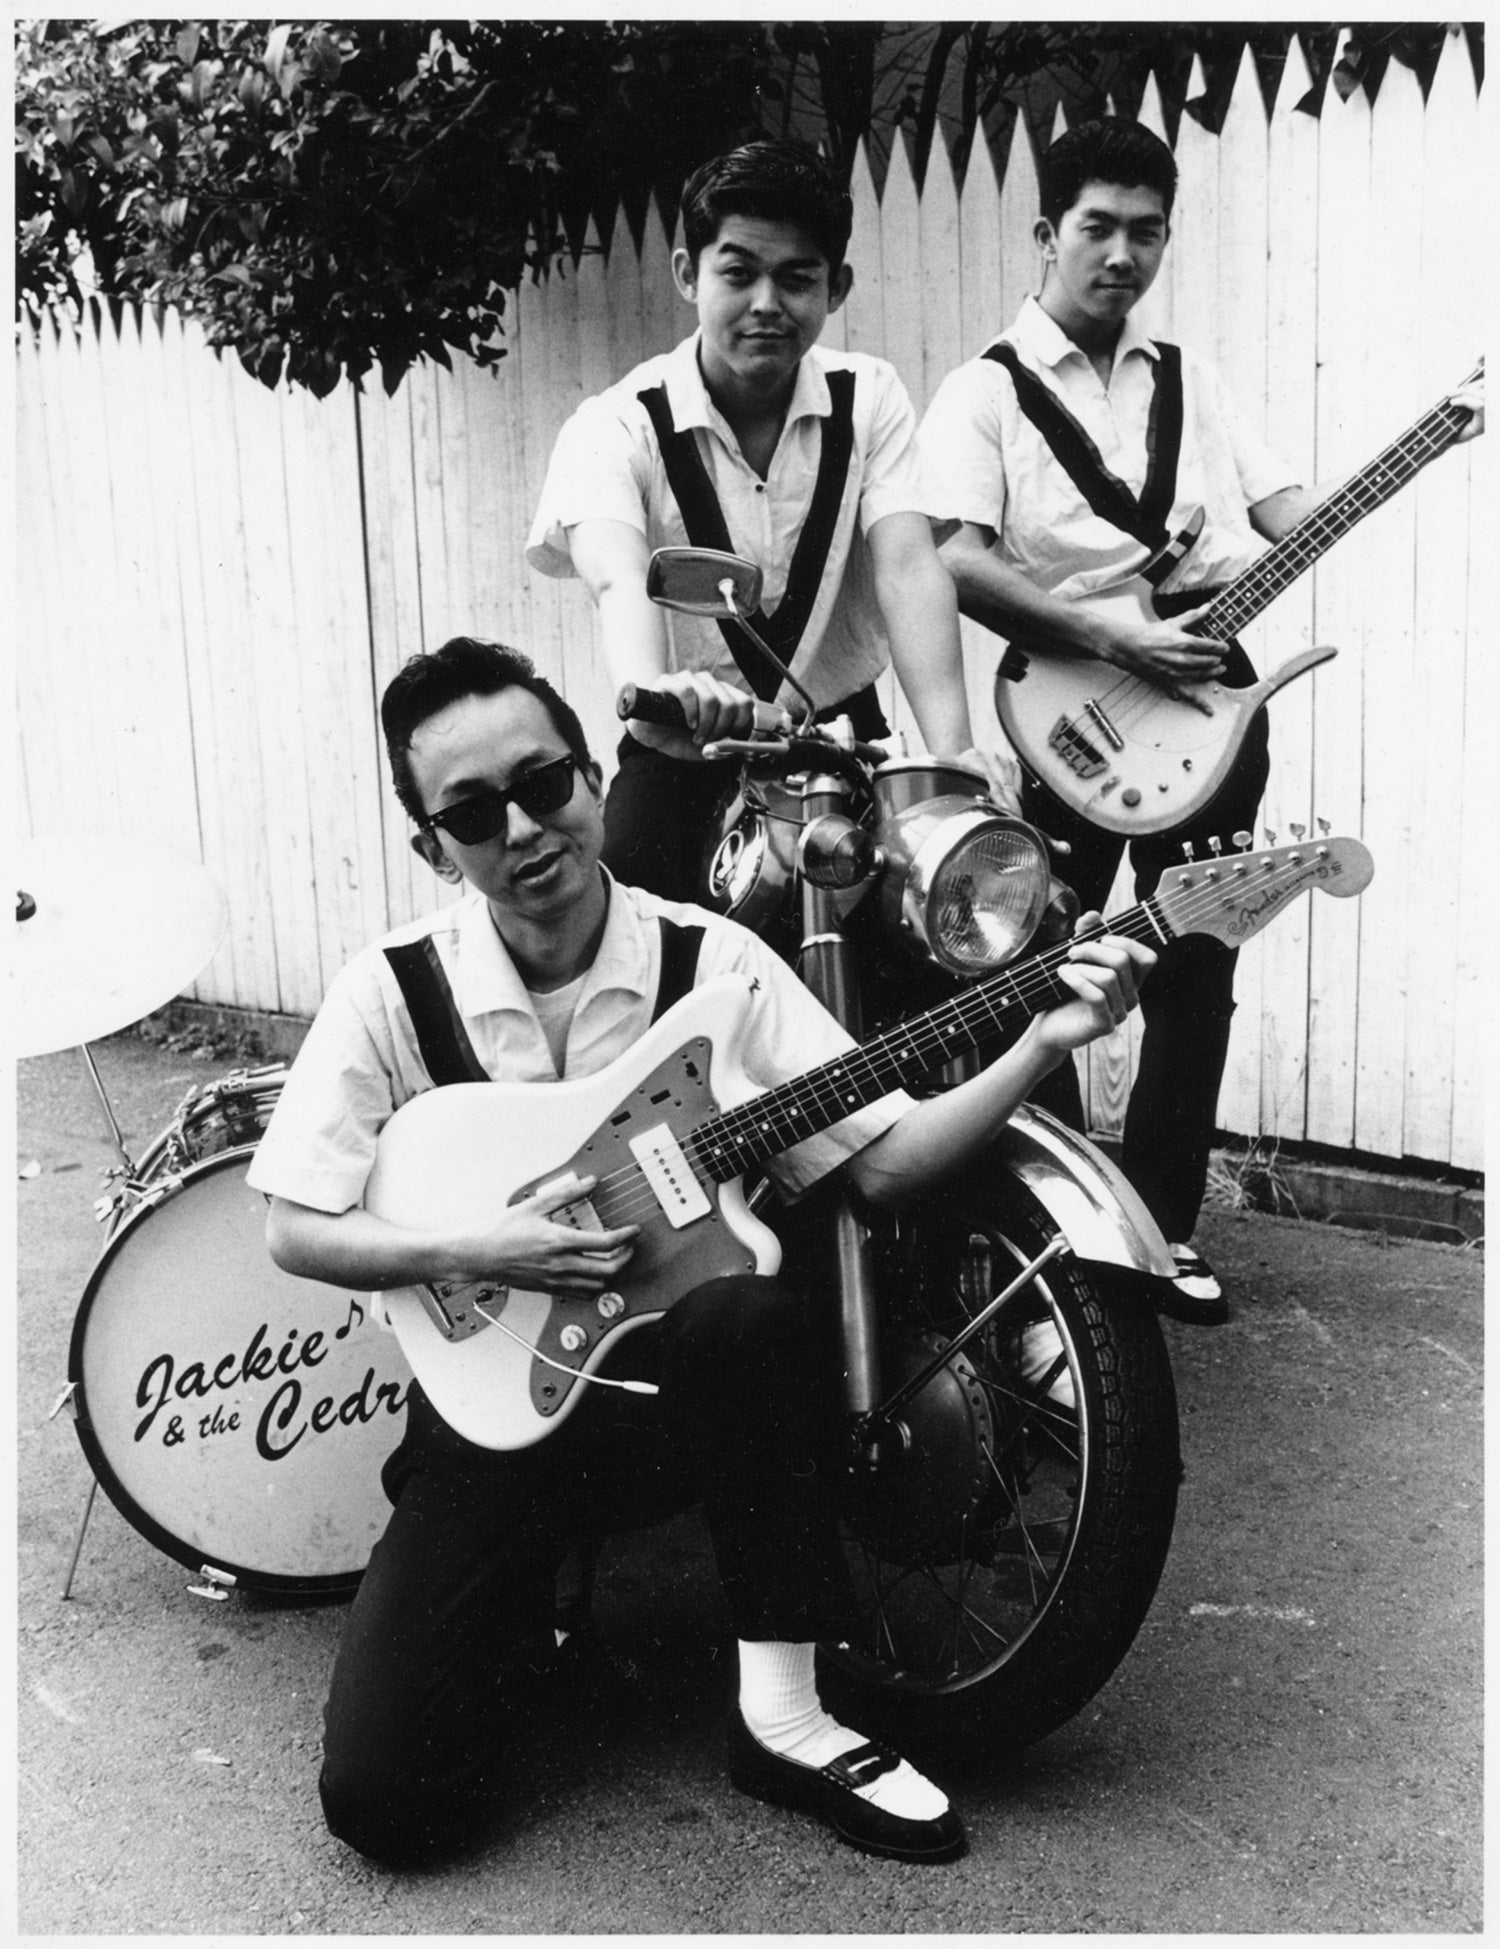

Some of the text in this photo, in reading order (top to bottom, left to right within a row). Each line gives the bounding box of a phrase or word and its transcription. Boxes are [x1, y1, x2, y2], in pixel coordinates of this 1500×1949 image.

[134, 1323, 328, 1442] Jackie
[162, 1367, 409, 1461] & the Cedr
